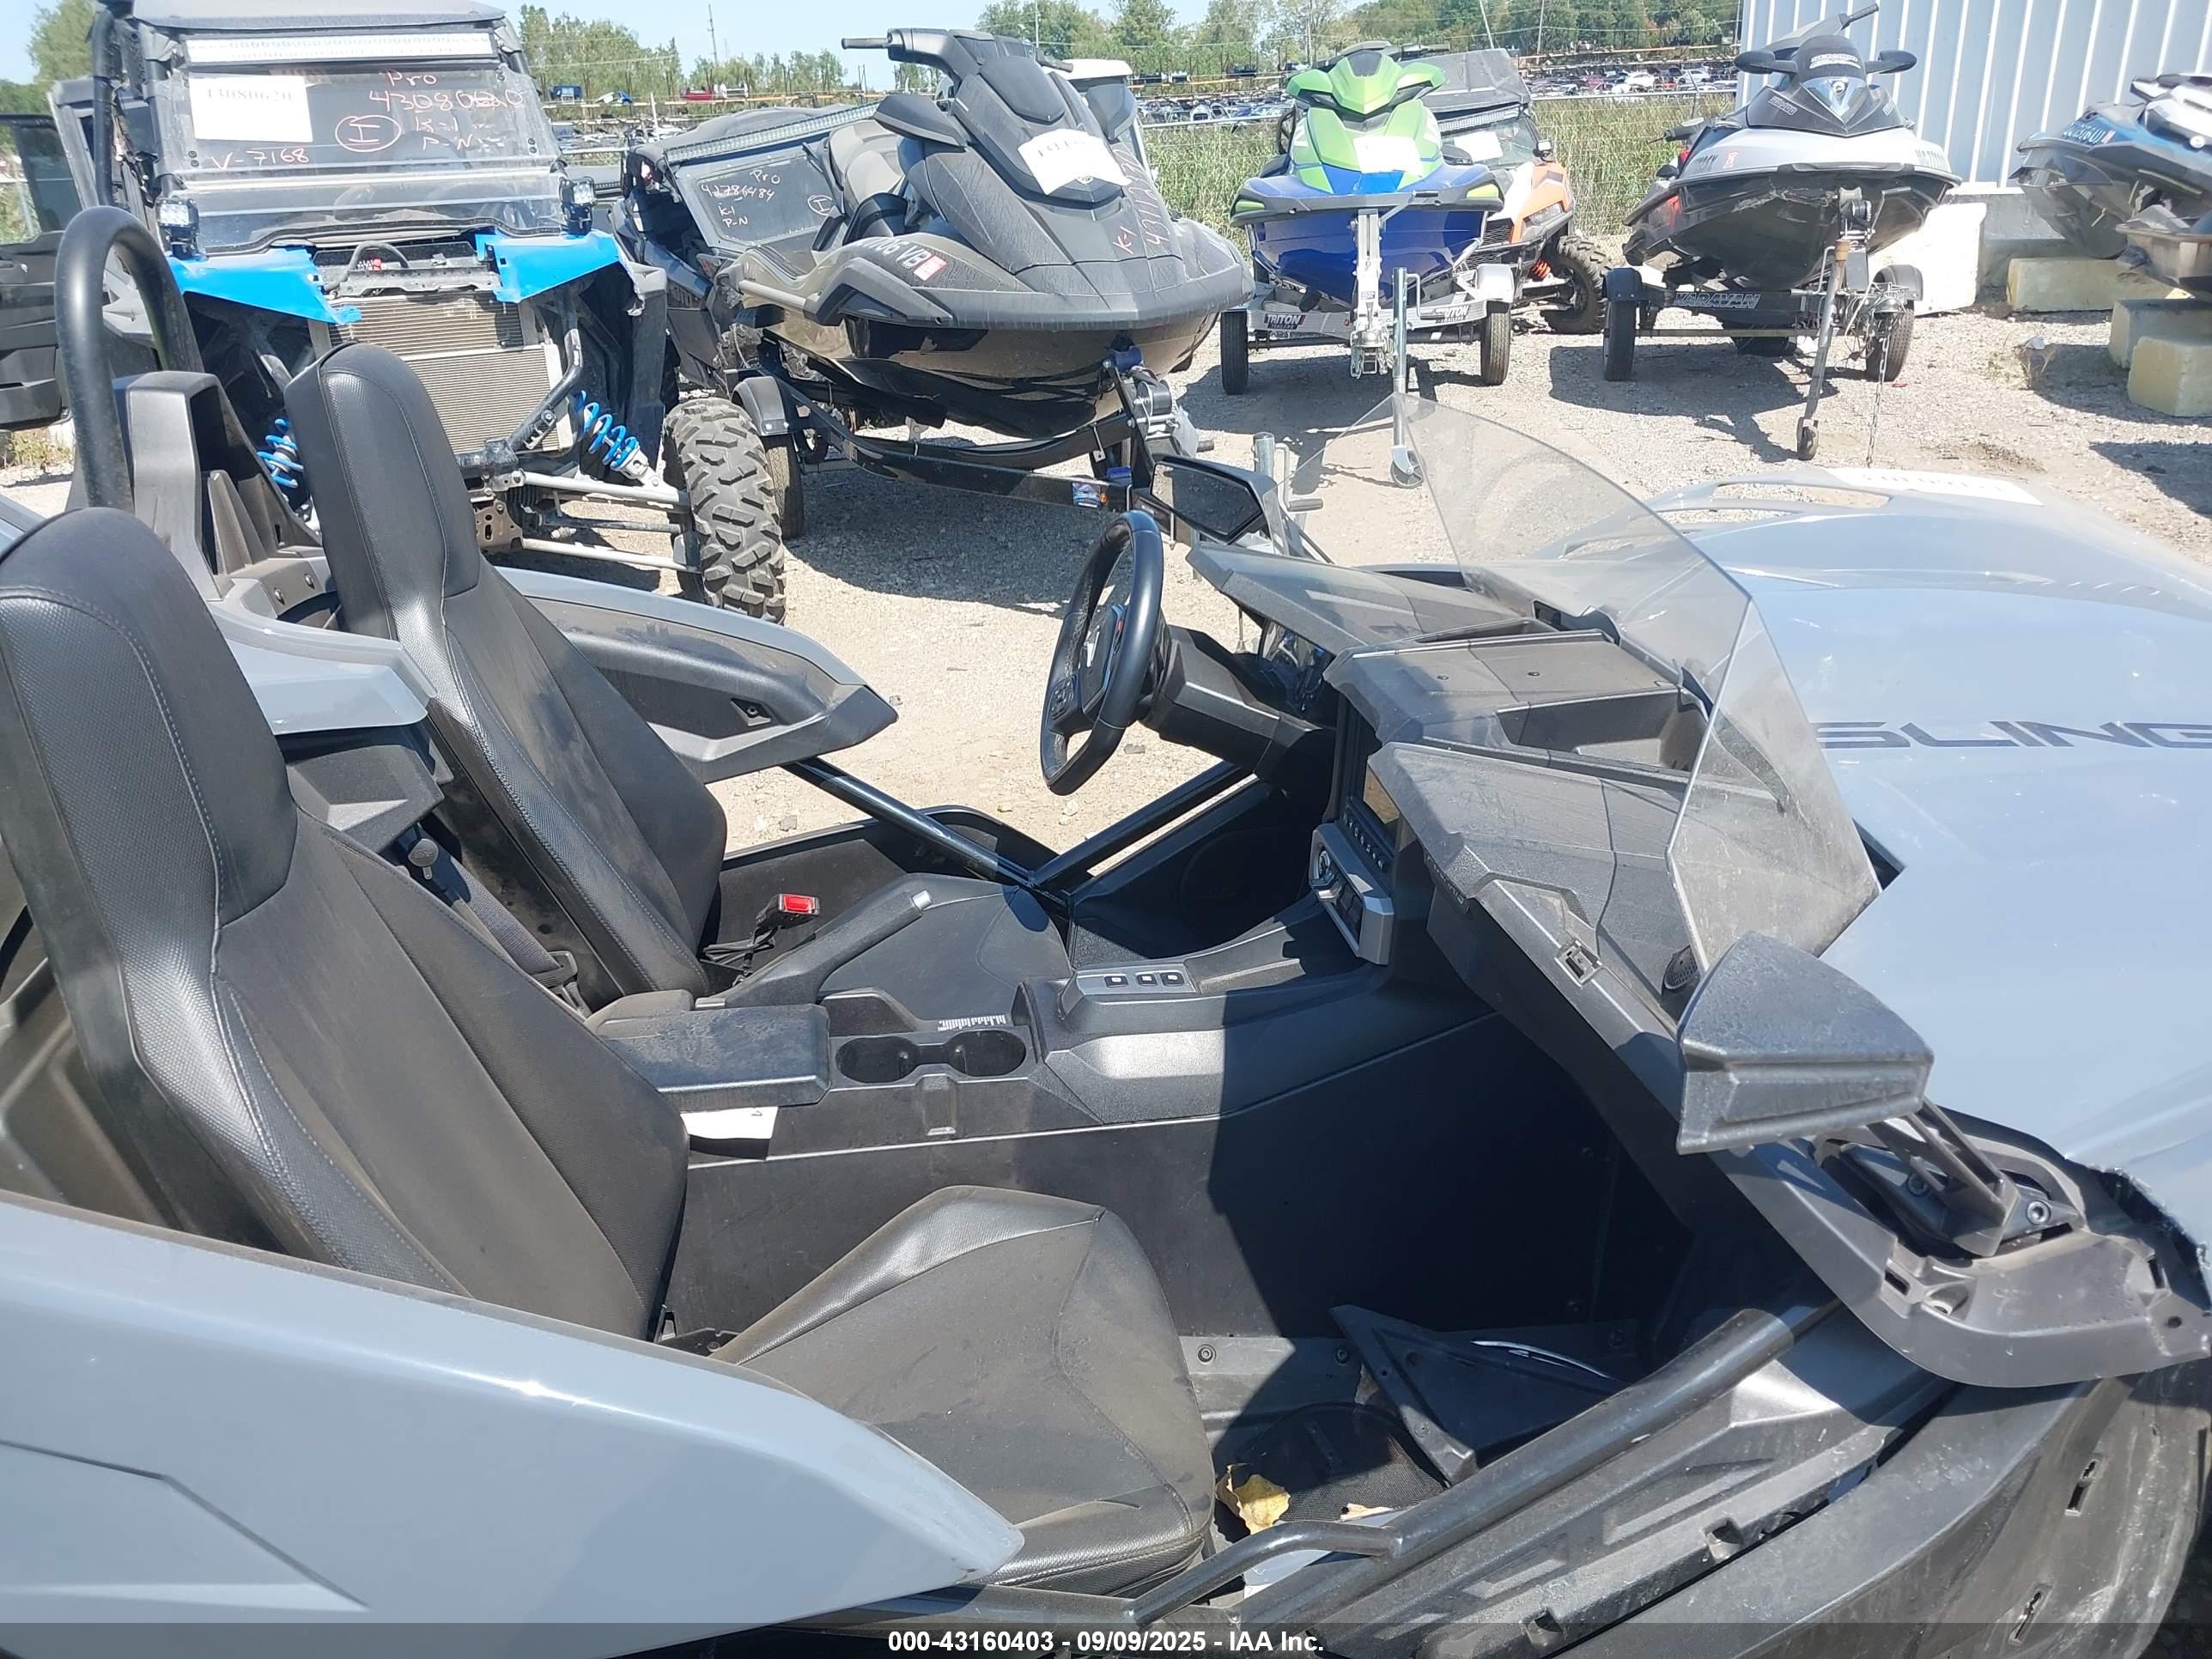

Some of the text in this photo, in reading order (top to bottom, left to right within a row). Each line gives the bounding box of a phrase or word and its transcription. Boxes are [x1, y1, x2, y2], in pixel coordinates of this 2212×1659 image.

[388, 70, 437, 86] Pro
[1675, 292, 1761, 309] KARAVAN
[1267, 314, 1302, 325] TRITON
